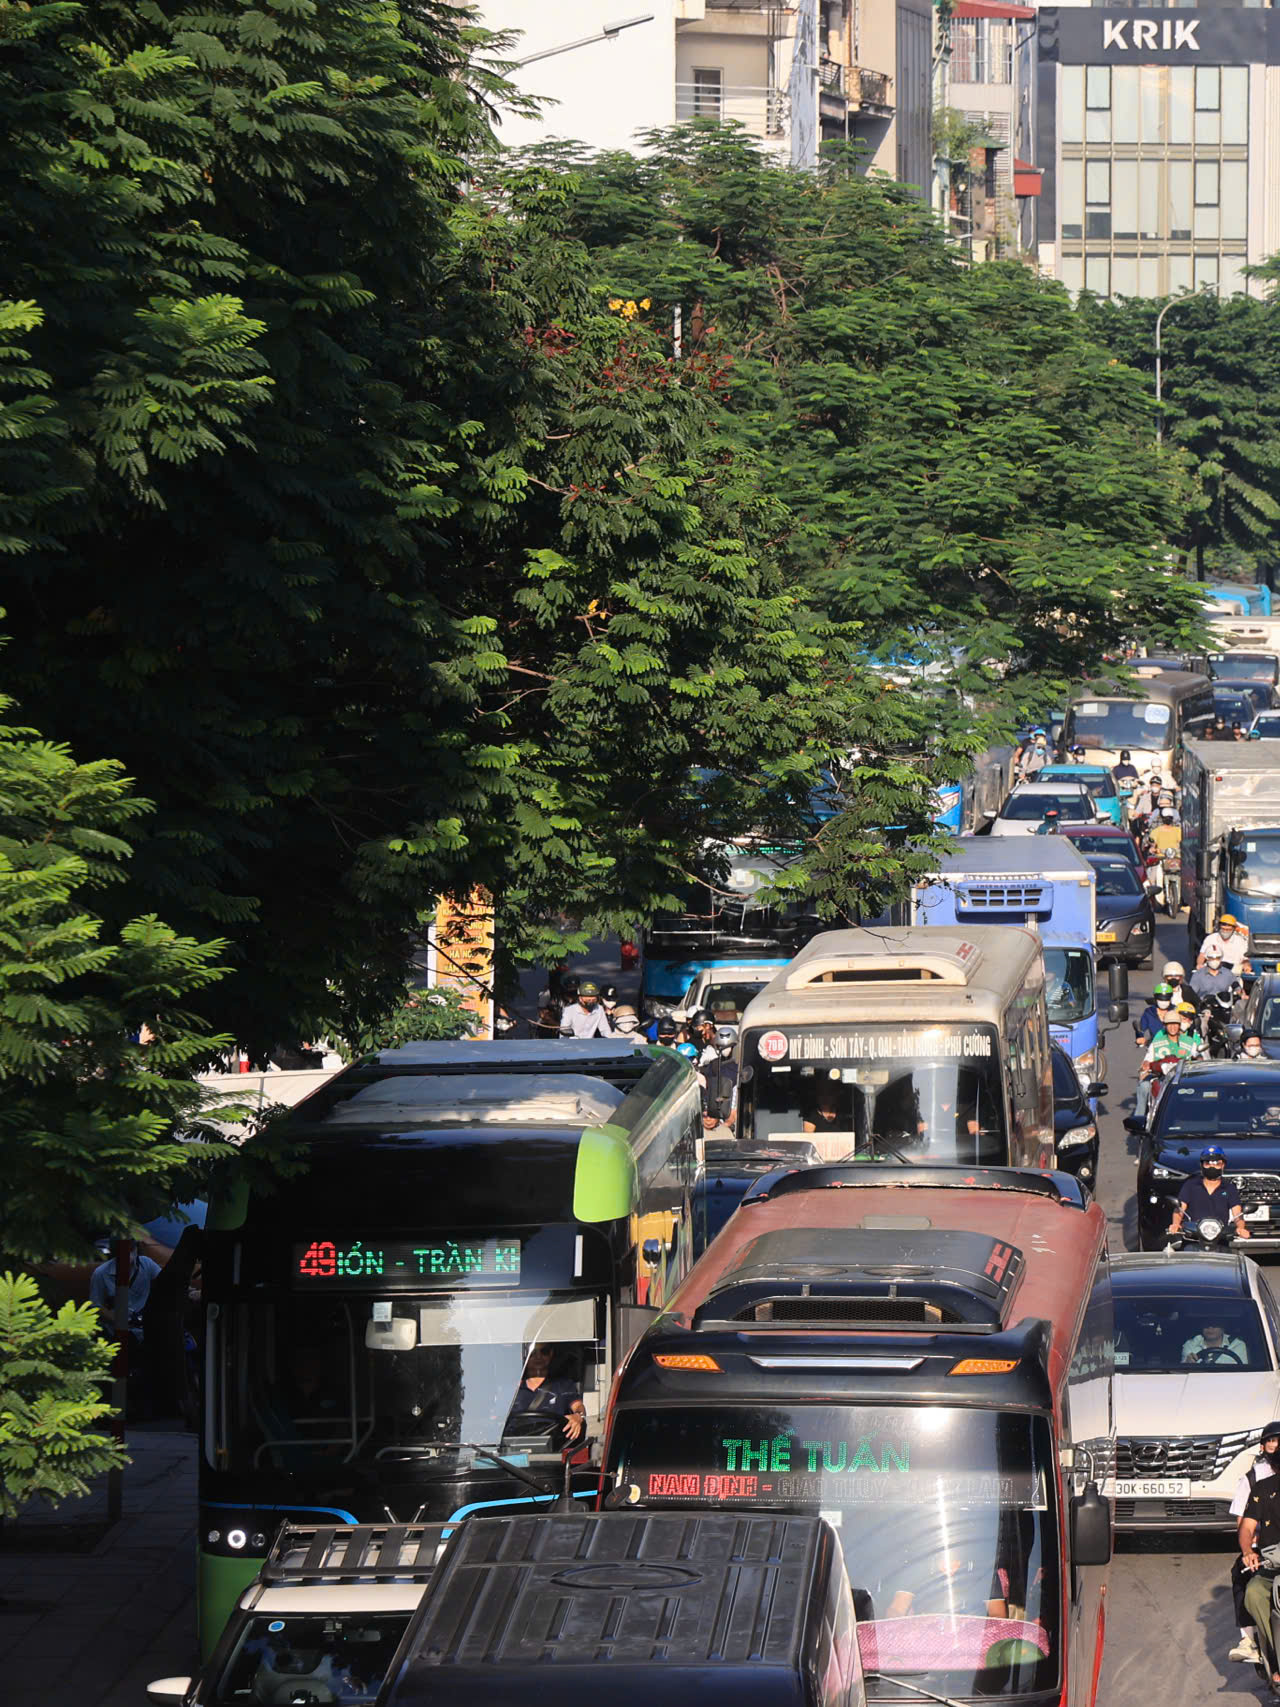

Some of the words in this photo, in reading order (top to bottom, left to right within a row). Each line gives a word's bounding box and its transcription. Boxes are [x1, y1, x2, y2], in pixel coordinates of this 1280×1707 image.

[1103, 19, 1200, 50] KRIK
[767, 1039, 784, 1051] 70B
[789, 1034, 802, 1059] MỸ
[803, 1033, 825, 1058] ĐÌNH
[830, 1035, 848, 1058] SƠN
[849, 1032, 865, 1058] TÂY
[944, 1030, 962, 1056] PHÚ
[963, 1028, 992, 1056] CƯỜNG
[300, 1241, 335, 1276] 49
[413, 1241, 483, 1273] TRẦN
[722, 1428, 795, 1472] THẾ
[802, 1430, 911, 1473] TUẤN
[648, 1473, 700, 1496] NAM
[703, 1475, 758, 1500] ĐỊNH
[1116, 1483, 1183, 1494] 30K-660.52
